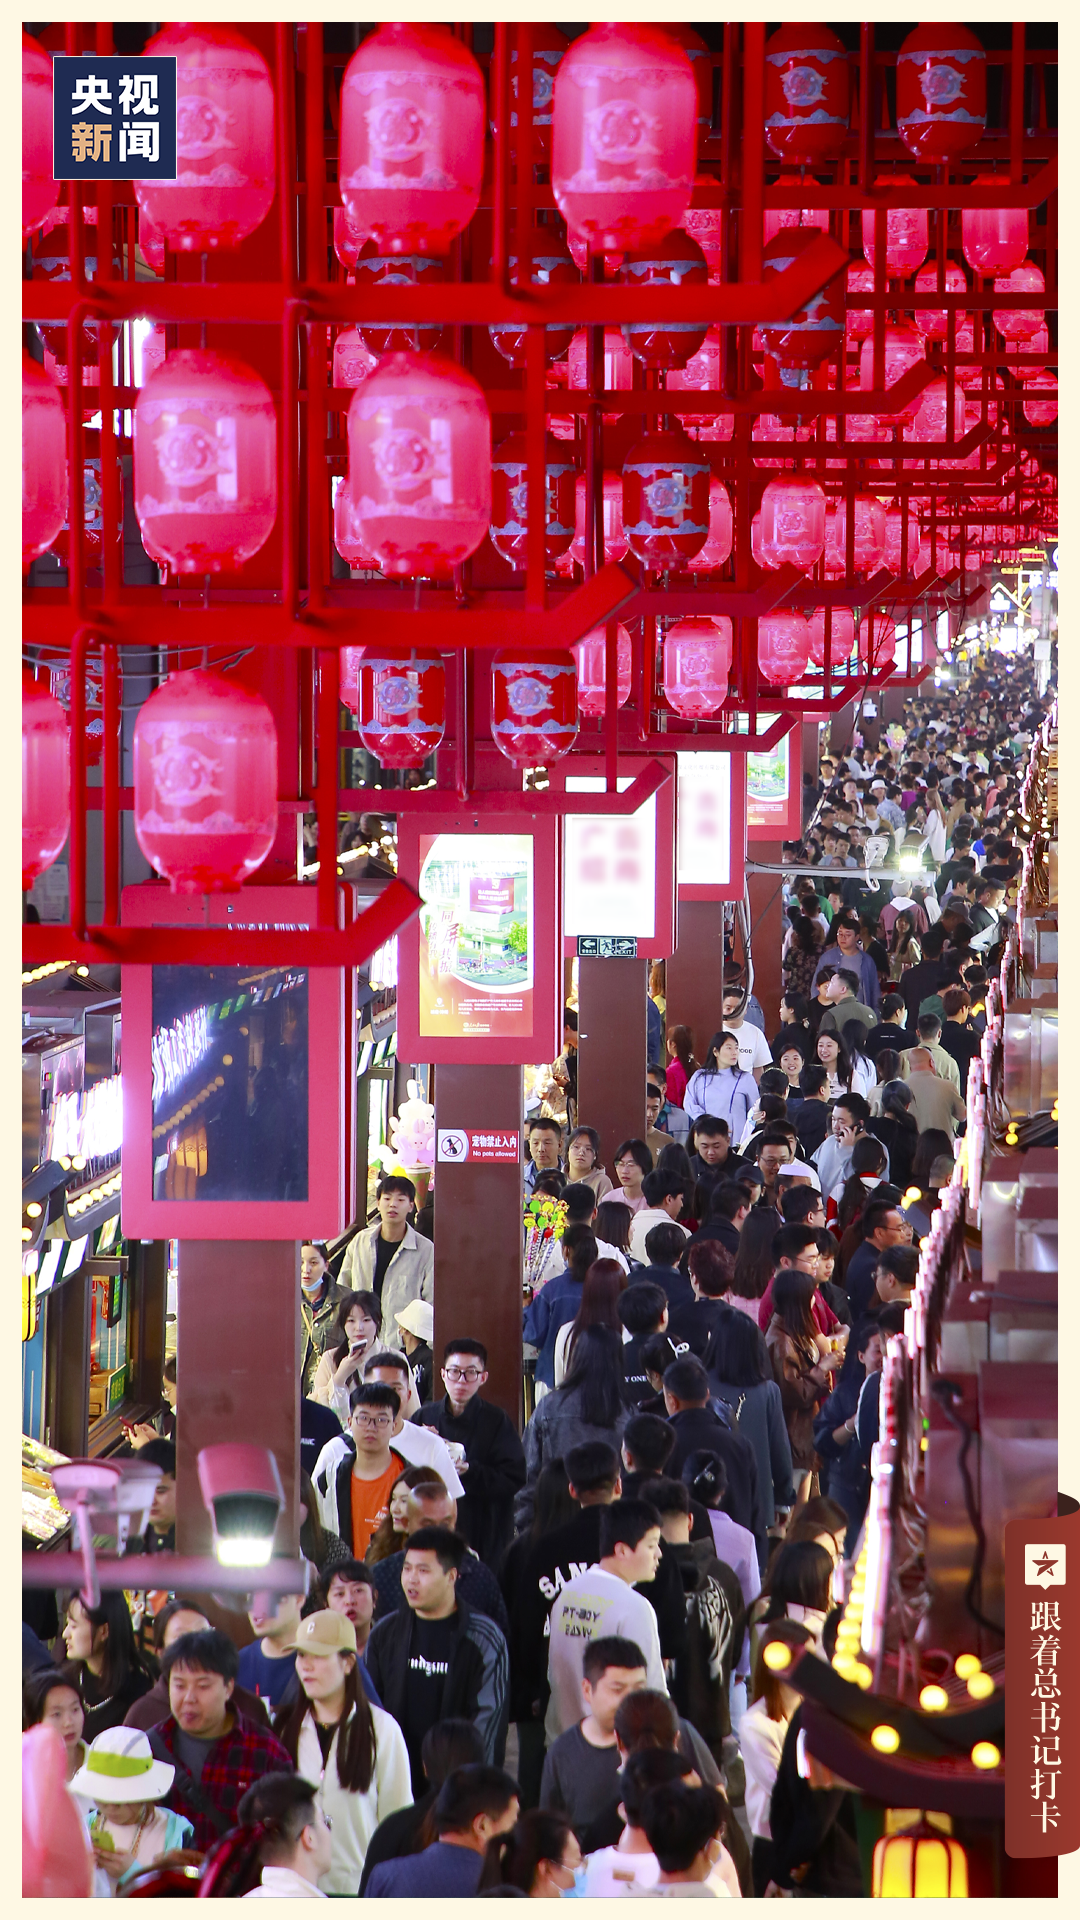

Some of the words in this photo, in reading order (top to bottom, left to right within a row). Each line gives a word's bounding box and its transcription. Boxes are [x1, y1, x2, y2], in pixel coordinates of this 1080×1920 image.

[472, 1135, 517, 1148] 宠物禁止入内
